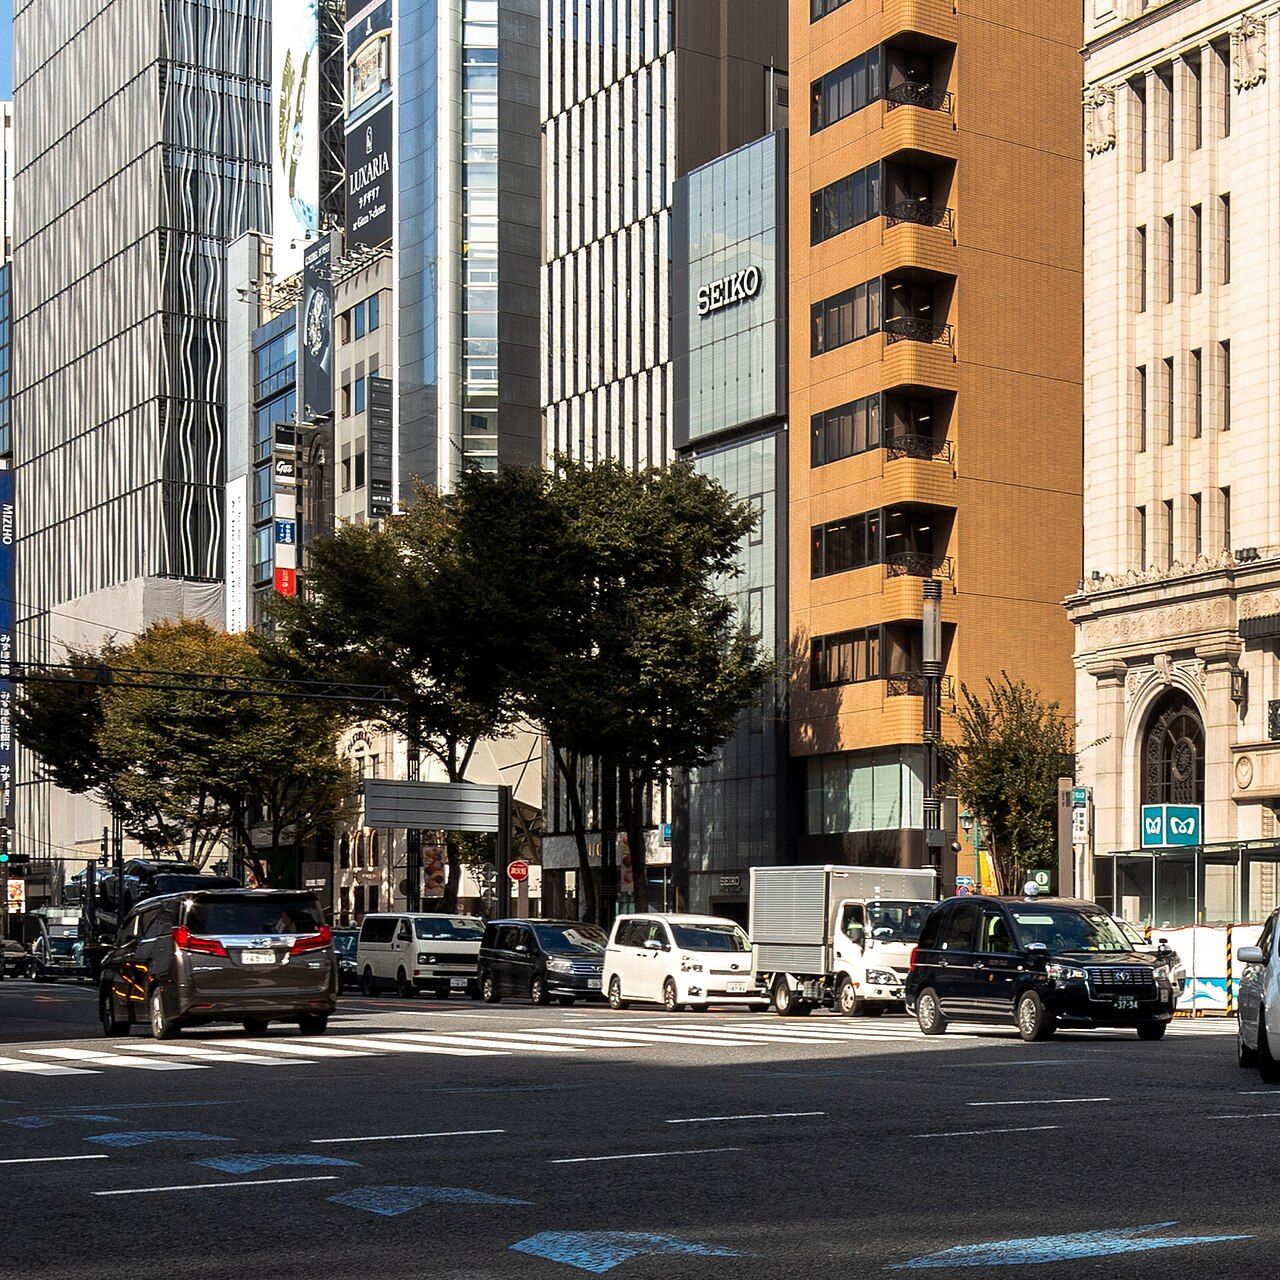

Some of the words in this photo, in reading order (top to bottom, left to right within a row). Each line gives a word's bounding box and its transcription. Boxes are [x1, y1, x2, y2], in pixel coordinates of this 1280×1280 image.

[350, 151, 390, 196] LUXARIA
[696, 265, 761, 316] SEIKO
[2, 503, 14, 545] MIZUHO
